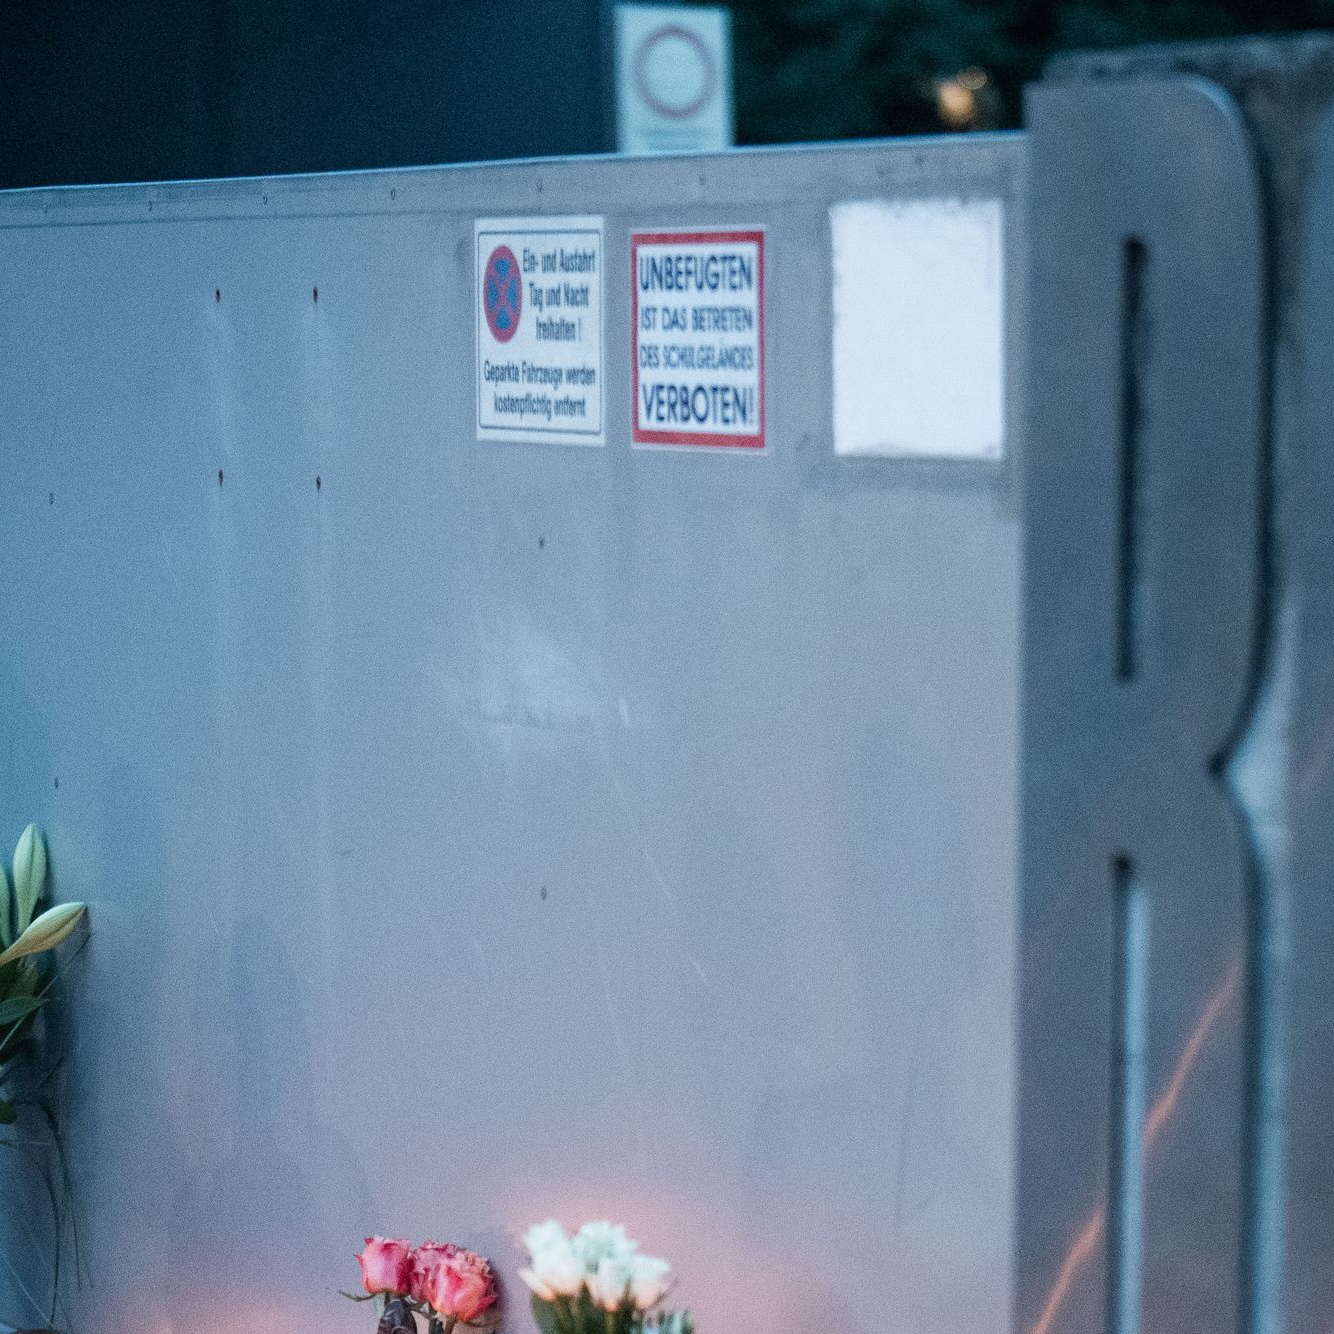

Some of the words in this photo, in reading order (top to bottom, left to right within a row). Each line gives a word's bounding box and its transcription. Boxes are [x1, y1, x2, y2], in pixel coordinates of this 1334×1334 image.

[523, 249, 539, 273] Ein-
[541, 249, 557, 273] und
[559, 248, 596, 273] Ausfahrt
[639, 254, 753, 291] UNBEFUGTEN
[529, 282, 543, 312] Tag
[545, 282, 561, 307] und
[563, 283, 589, 308] Nacht
[535, 316, 576, 341] freihalten
[641, 306, 657, 331] IST
[661, 306, 687, 331] DAS
[691, 305, 753, 332] BETRETEN
[639, 344, 660, 369] DES
[483, 360, 519, 387] Geparkte
[522, 360, 564, 389] Fahrzeuge
[565, 364, 596, 386] werden
[493, 392, 552, 421] kostenpflichtig
[554, 394, 586, 417] entfernt
[642, 384, 754, 425] VERBOTEN!
